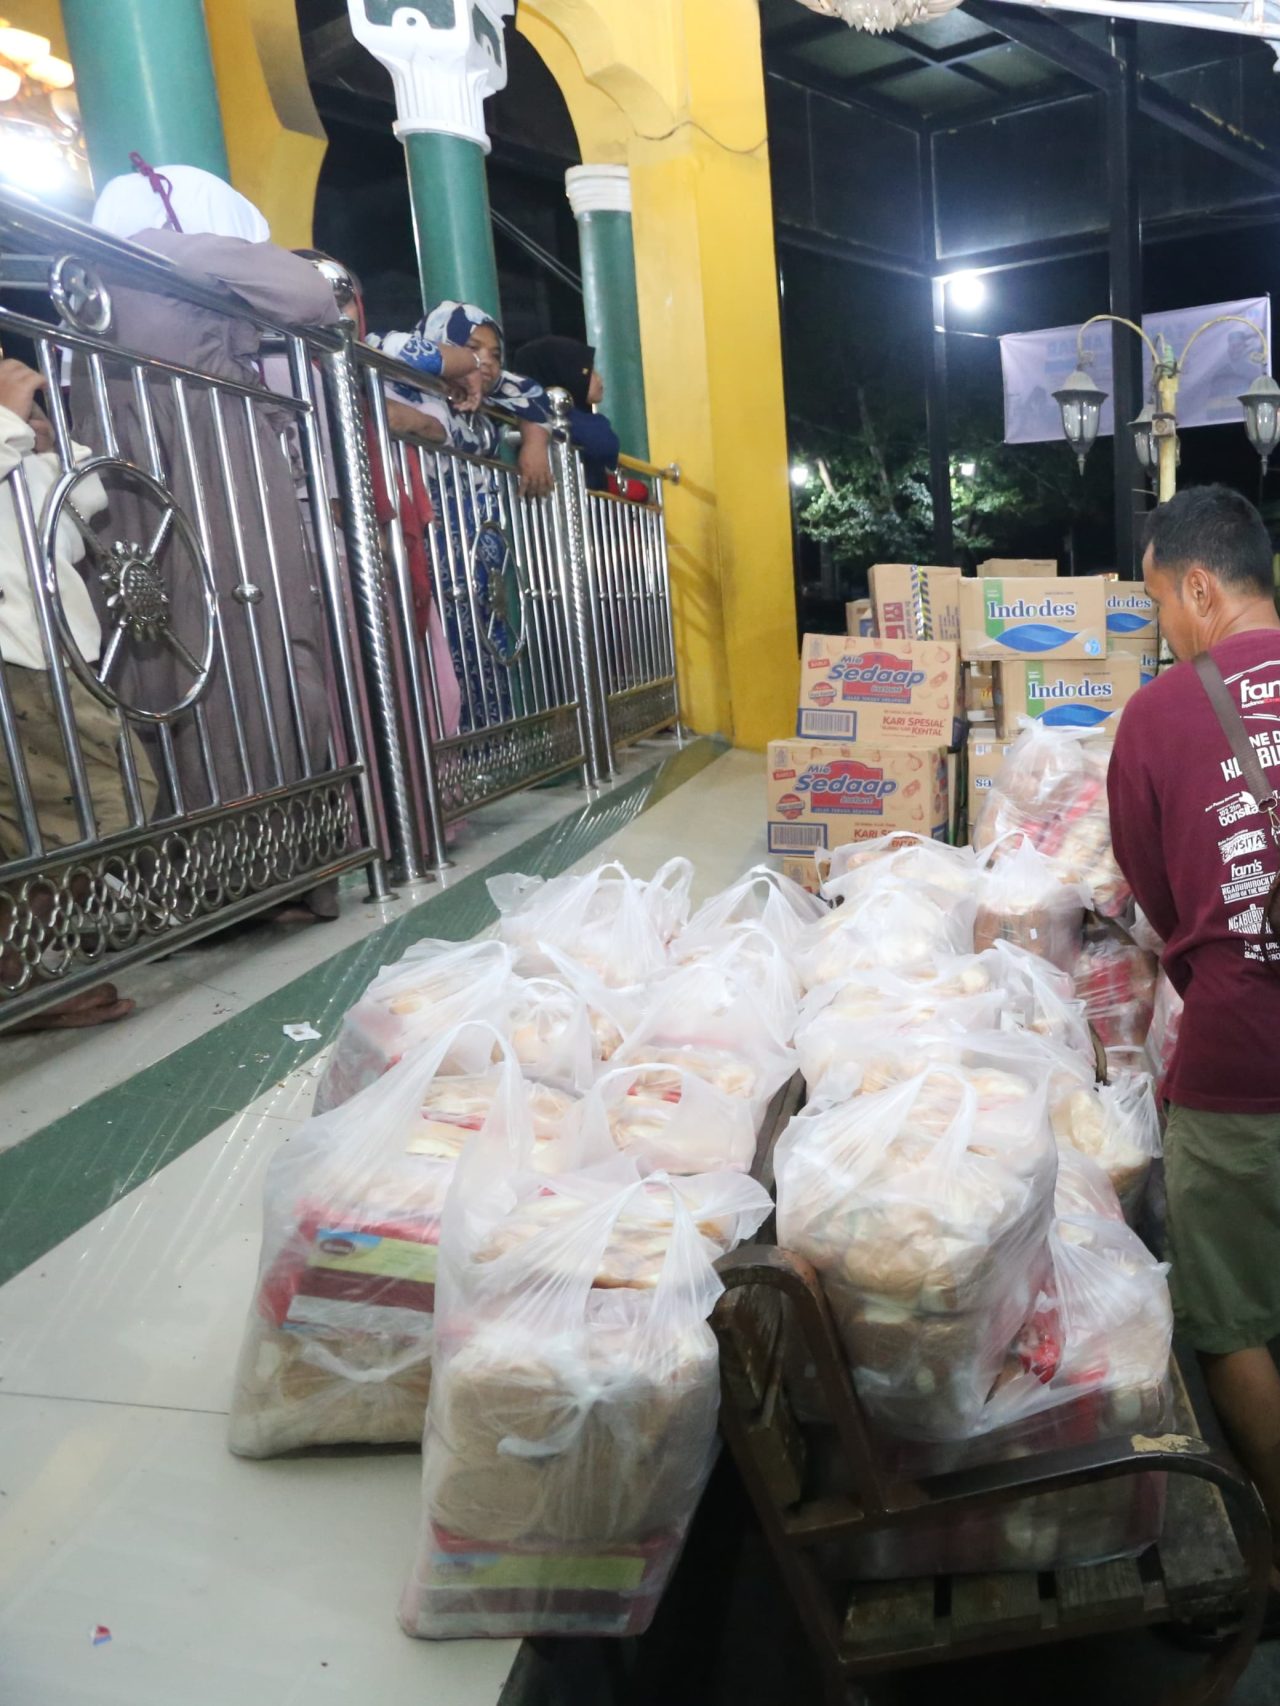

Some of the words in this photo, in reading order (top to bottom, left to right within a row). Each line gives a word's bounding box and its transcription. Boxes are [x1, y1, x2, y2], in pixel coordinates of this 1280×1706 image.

[988, 599, 1076, 618] Indodes
[1106, 595, 1152, 609] dodes
[828, 664, 927, 689] Sedaap
[1029, 679, 1113, 699] Indodes
[882, 716, 906, 726] KARI
[907, 717, 946, 728] SPESIAL
[911, 726, 943, 737] KENTAL
[794, 773, 898, 799] Sedaap
[1218, 803, 1260, 828] bonsita
[854, 828, 879, 839] KARI
[1231, 858, 1263, 879] fam's
